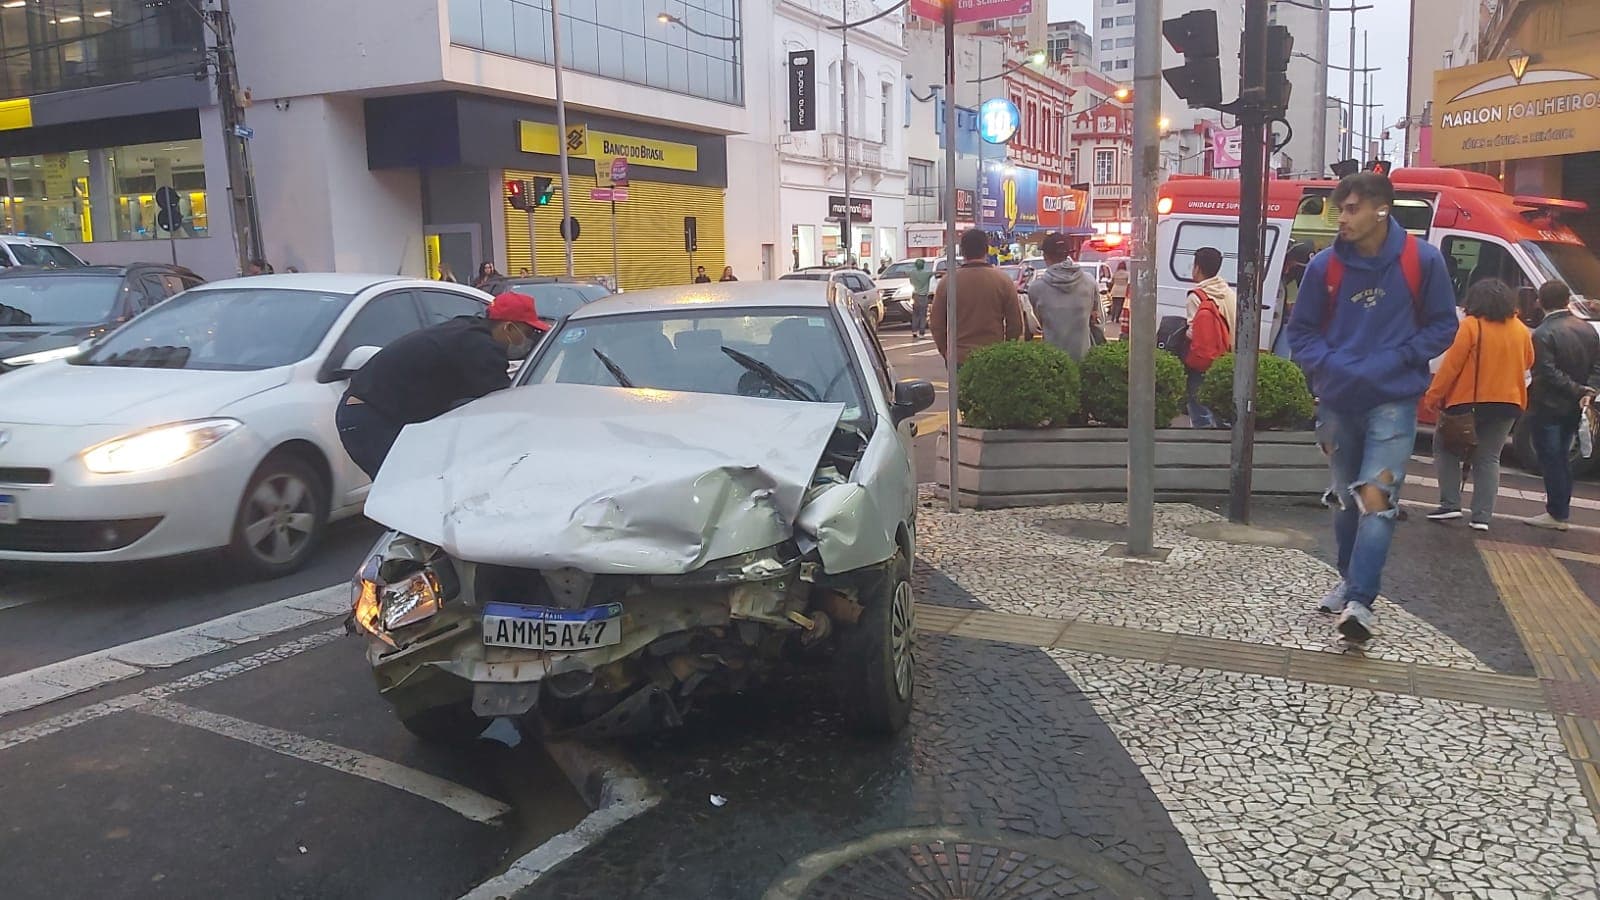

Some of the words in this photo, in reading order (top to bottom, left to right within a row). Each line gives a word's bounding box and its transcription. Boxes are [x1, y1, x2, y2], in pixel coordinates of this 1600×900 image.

[1441, 104, 1502, 129] MARLON
[603, 140, 629, 156] BANCO
[630, 146, 641, 159] DO
[641, 145, 665, 161] BRASIL
[1002, 178, 1018, 228] 10
[1188, 201, 1216, 209] UNIDADE
[1216, 202, 1225, 210] DE
[1226, 202, 1240, 210] SUP
[1267, 204, 1281, 212] ICO
[496, 619, 607, 646] AMM5A47
